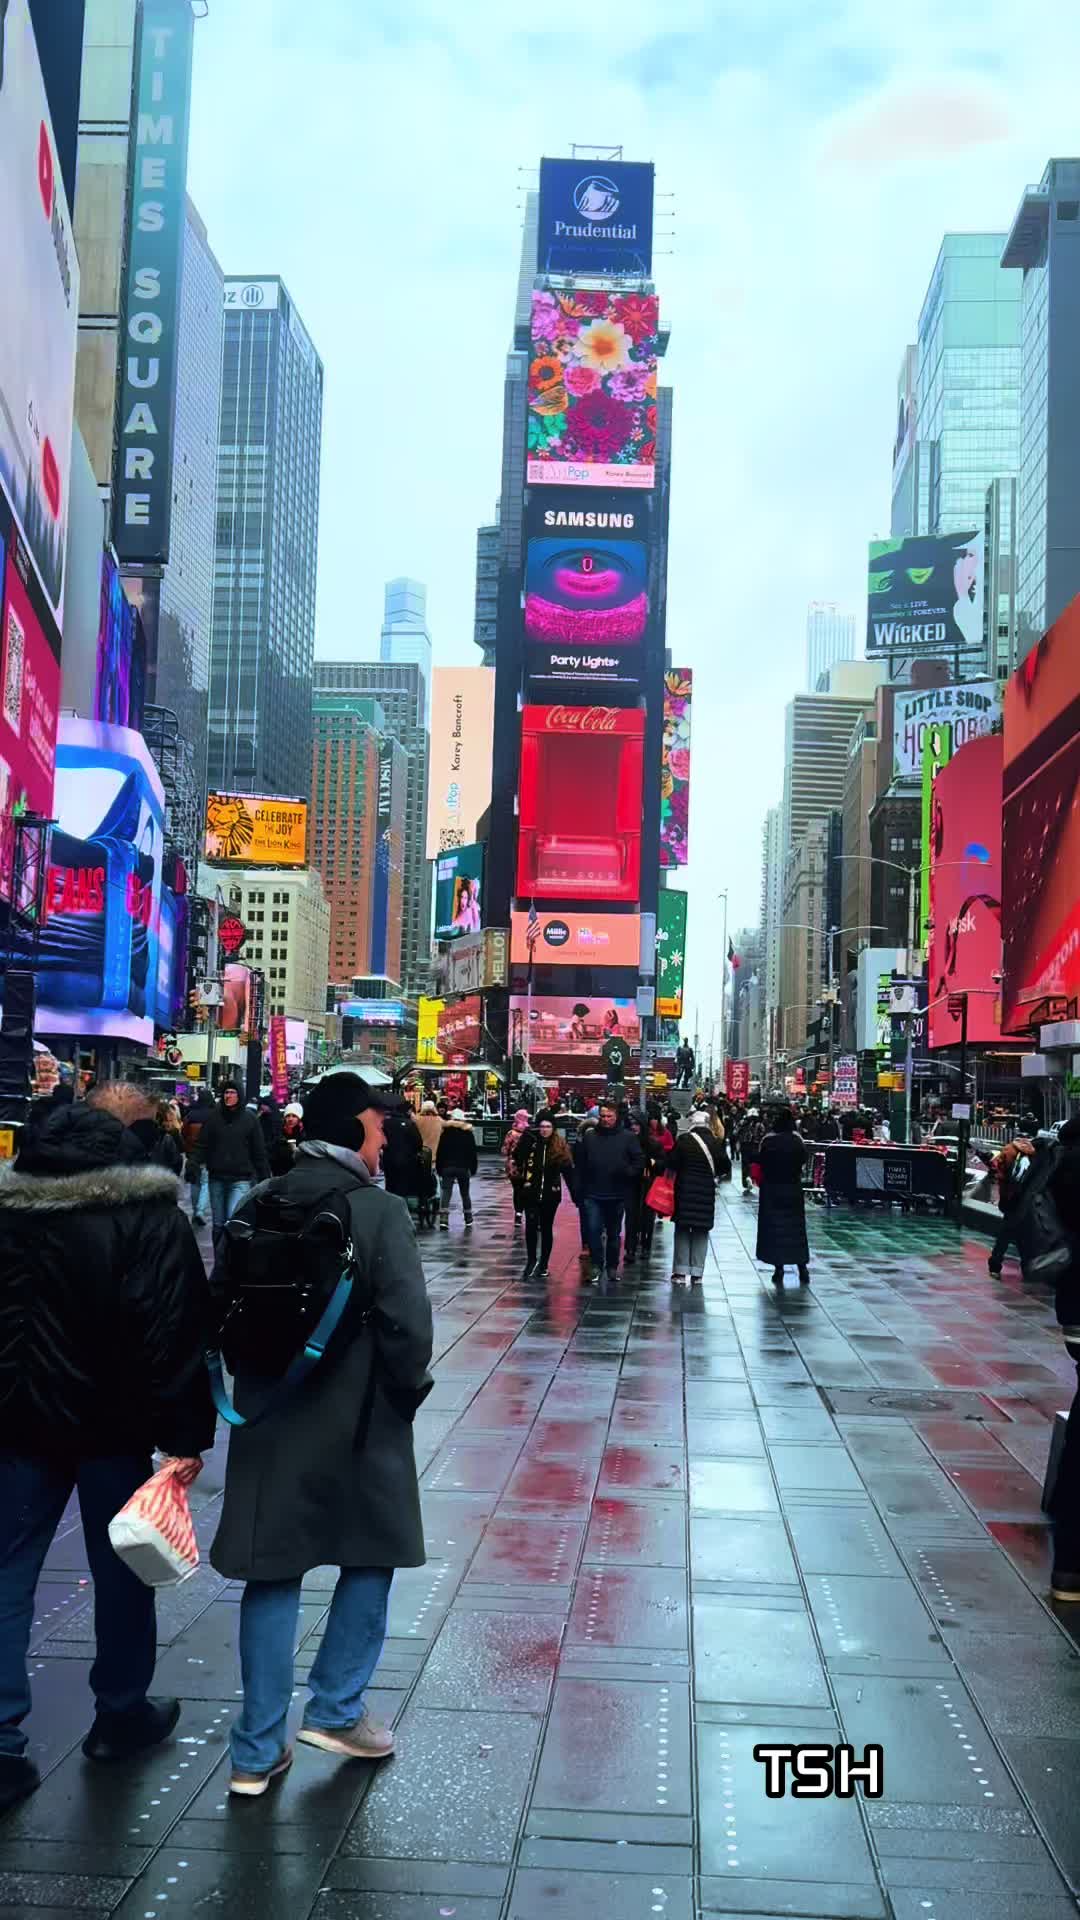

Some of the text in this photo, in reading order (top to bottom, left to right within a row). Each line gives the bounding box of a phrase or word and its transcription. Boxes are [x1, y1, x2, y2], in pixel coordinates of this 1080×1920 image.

[553, 220, 637, 239] Prudential
[124, 27, 174, 525] TIMES SQUARE
[544, 510, 635, 529] SAMSUNG
[550, 655, 581, 668] Party
[904, 689, 992, 721] LITTLE SHOP
[451, 694, 463, 738] Bancroft
[450, 741, 463, 771] Karey
[254, 809, 304, 825] CELEBRATE
[275, 825, 294, 837] JOY
